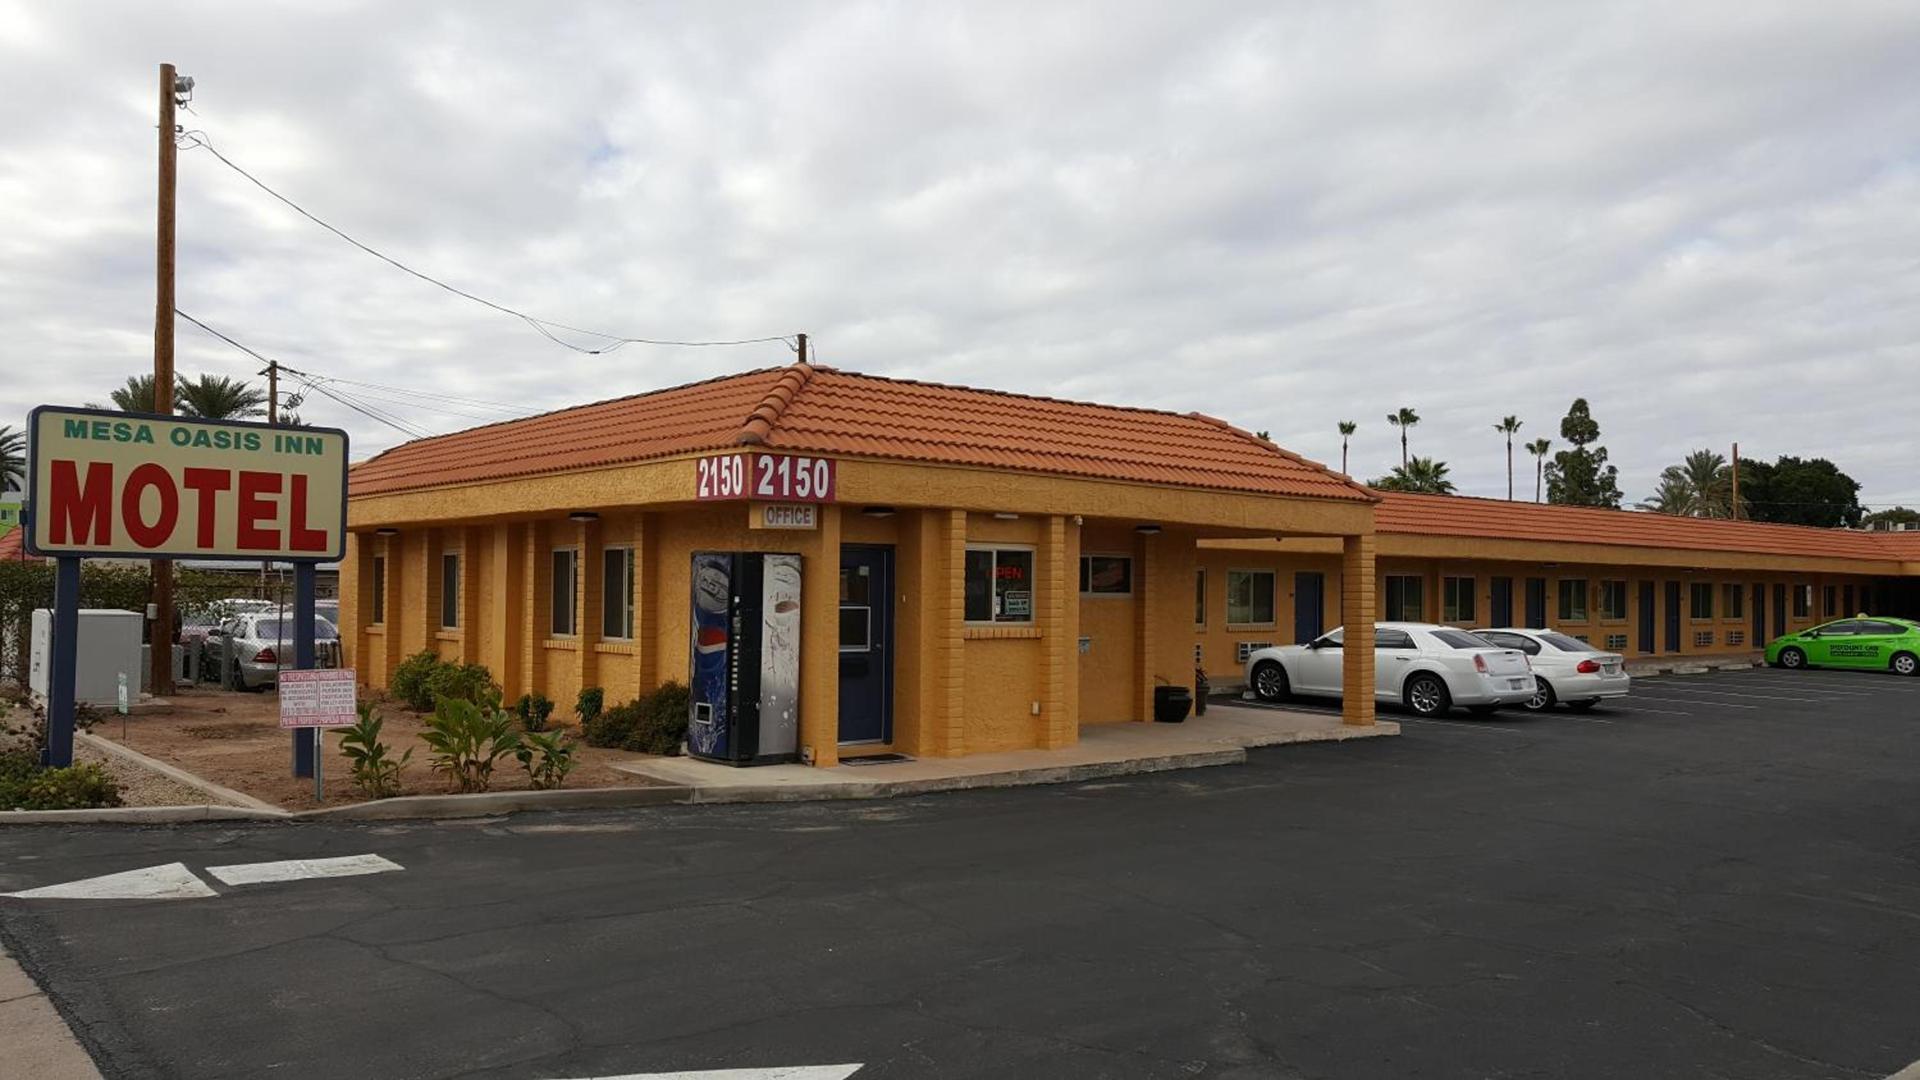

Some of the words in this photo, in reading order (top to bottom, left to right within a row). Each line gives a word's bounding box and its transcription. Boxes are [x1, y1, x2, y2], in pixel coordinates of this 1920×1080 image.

[64, 419, 154, 444] MESA
[170, 427, 261, 451] OASIS
[275, 435, 323, 455] INN
[699, 455, 743, 497] 2150
[757, 454, 829, 498] 2150
[49, 460, 327, 552] MOTEL
[766, 506, 811, 524] OFFICE
